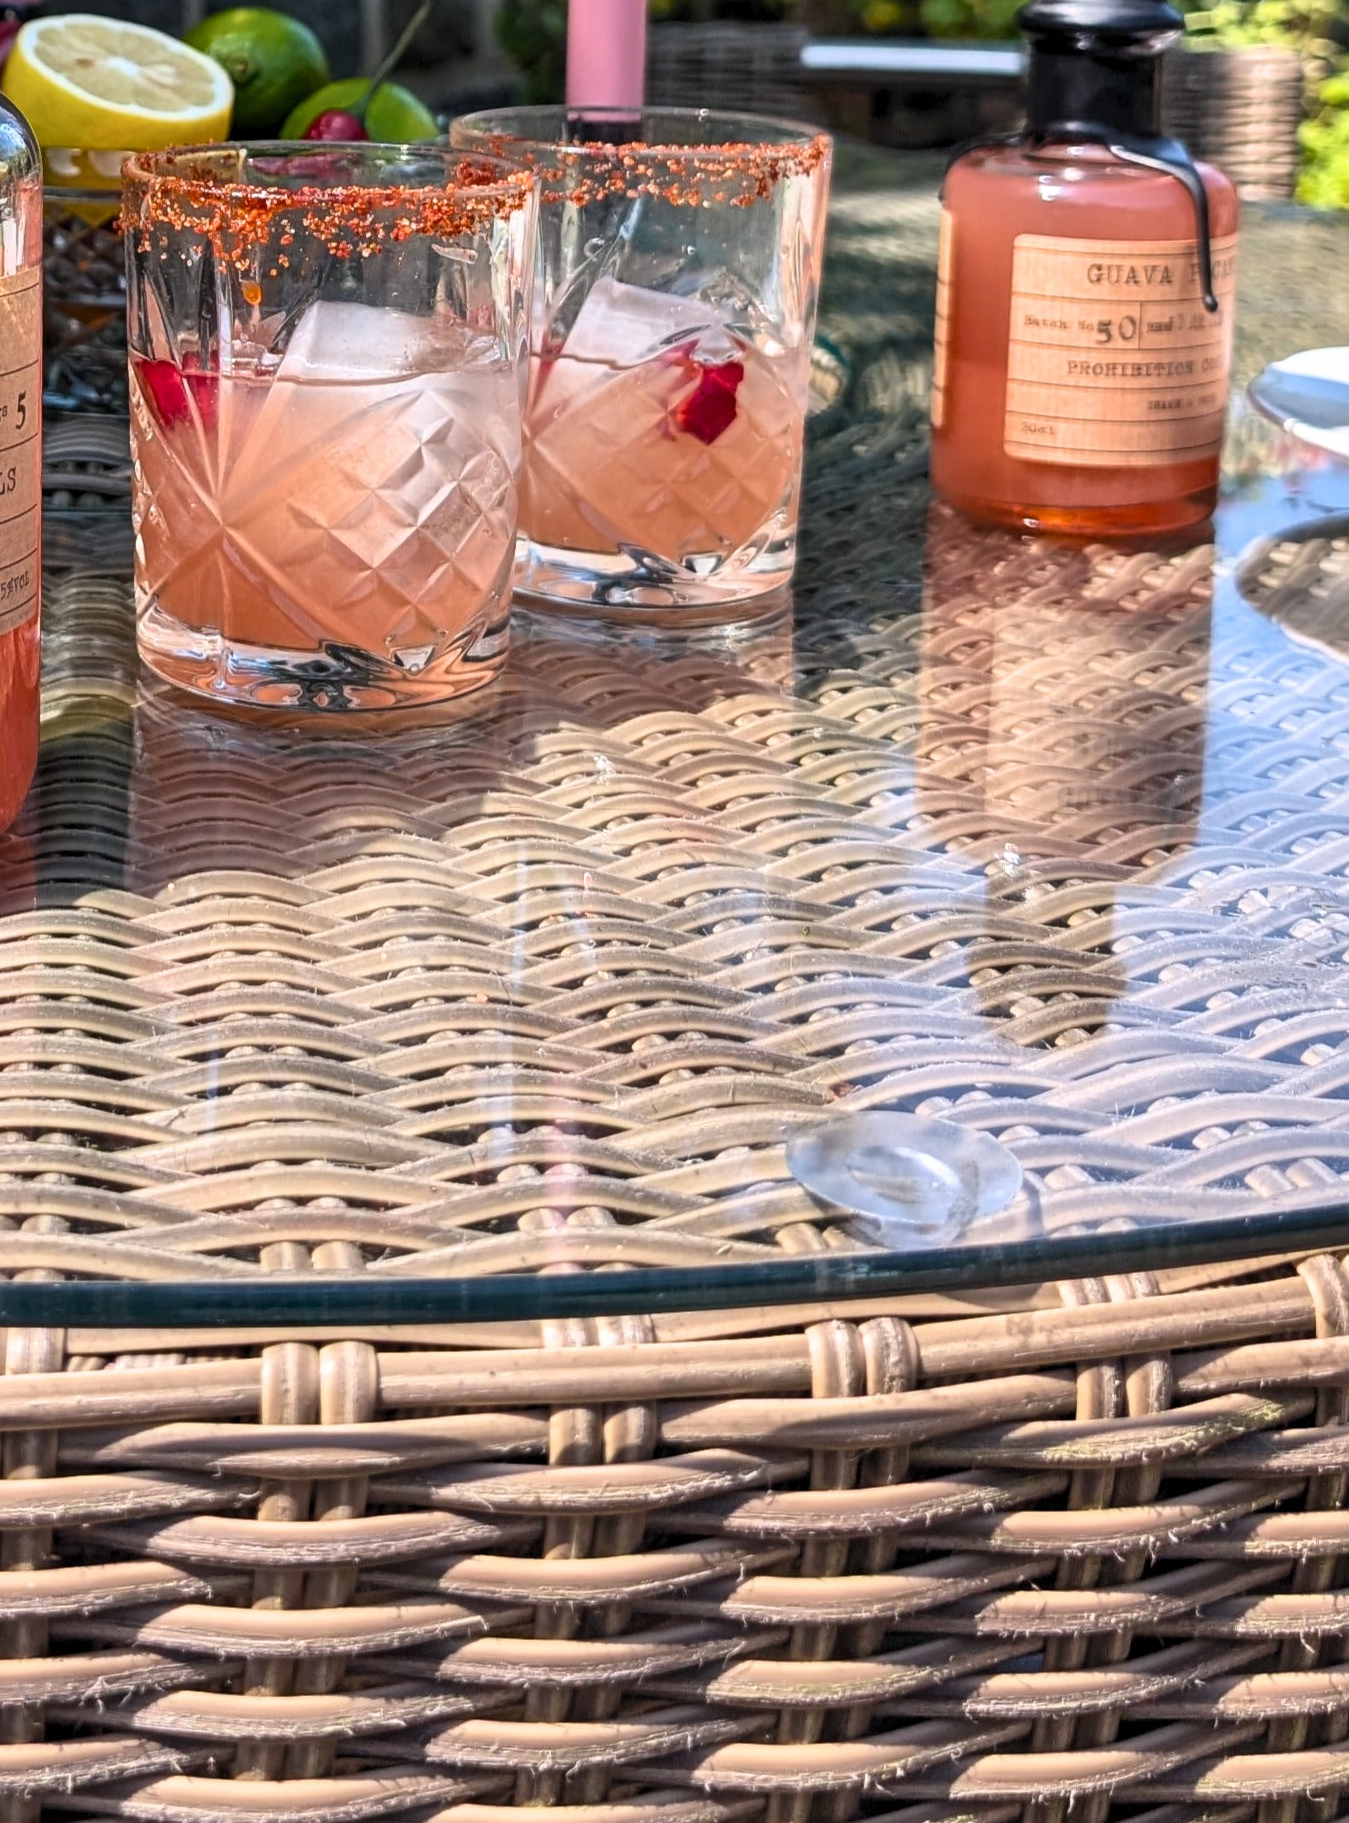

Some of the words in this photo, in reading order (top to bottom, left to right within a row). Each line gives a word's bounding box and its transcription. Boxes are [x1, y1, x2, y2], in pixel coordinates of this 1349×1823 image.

[1087, 263, 1172, 285] GUAVA
[1095, 315, 1137, 344] 50
[15, 390, 27, 430] 5
